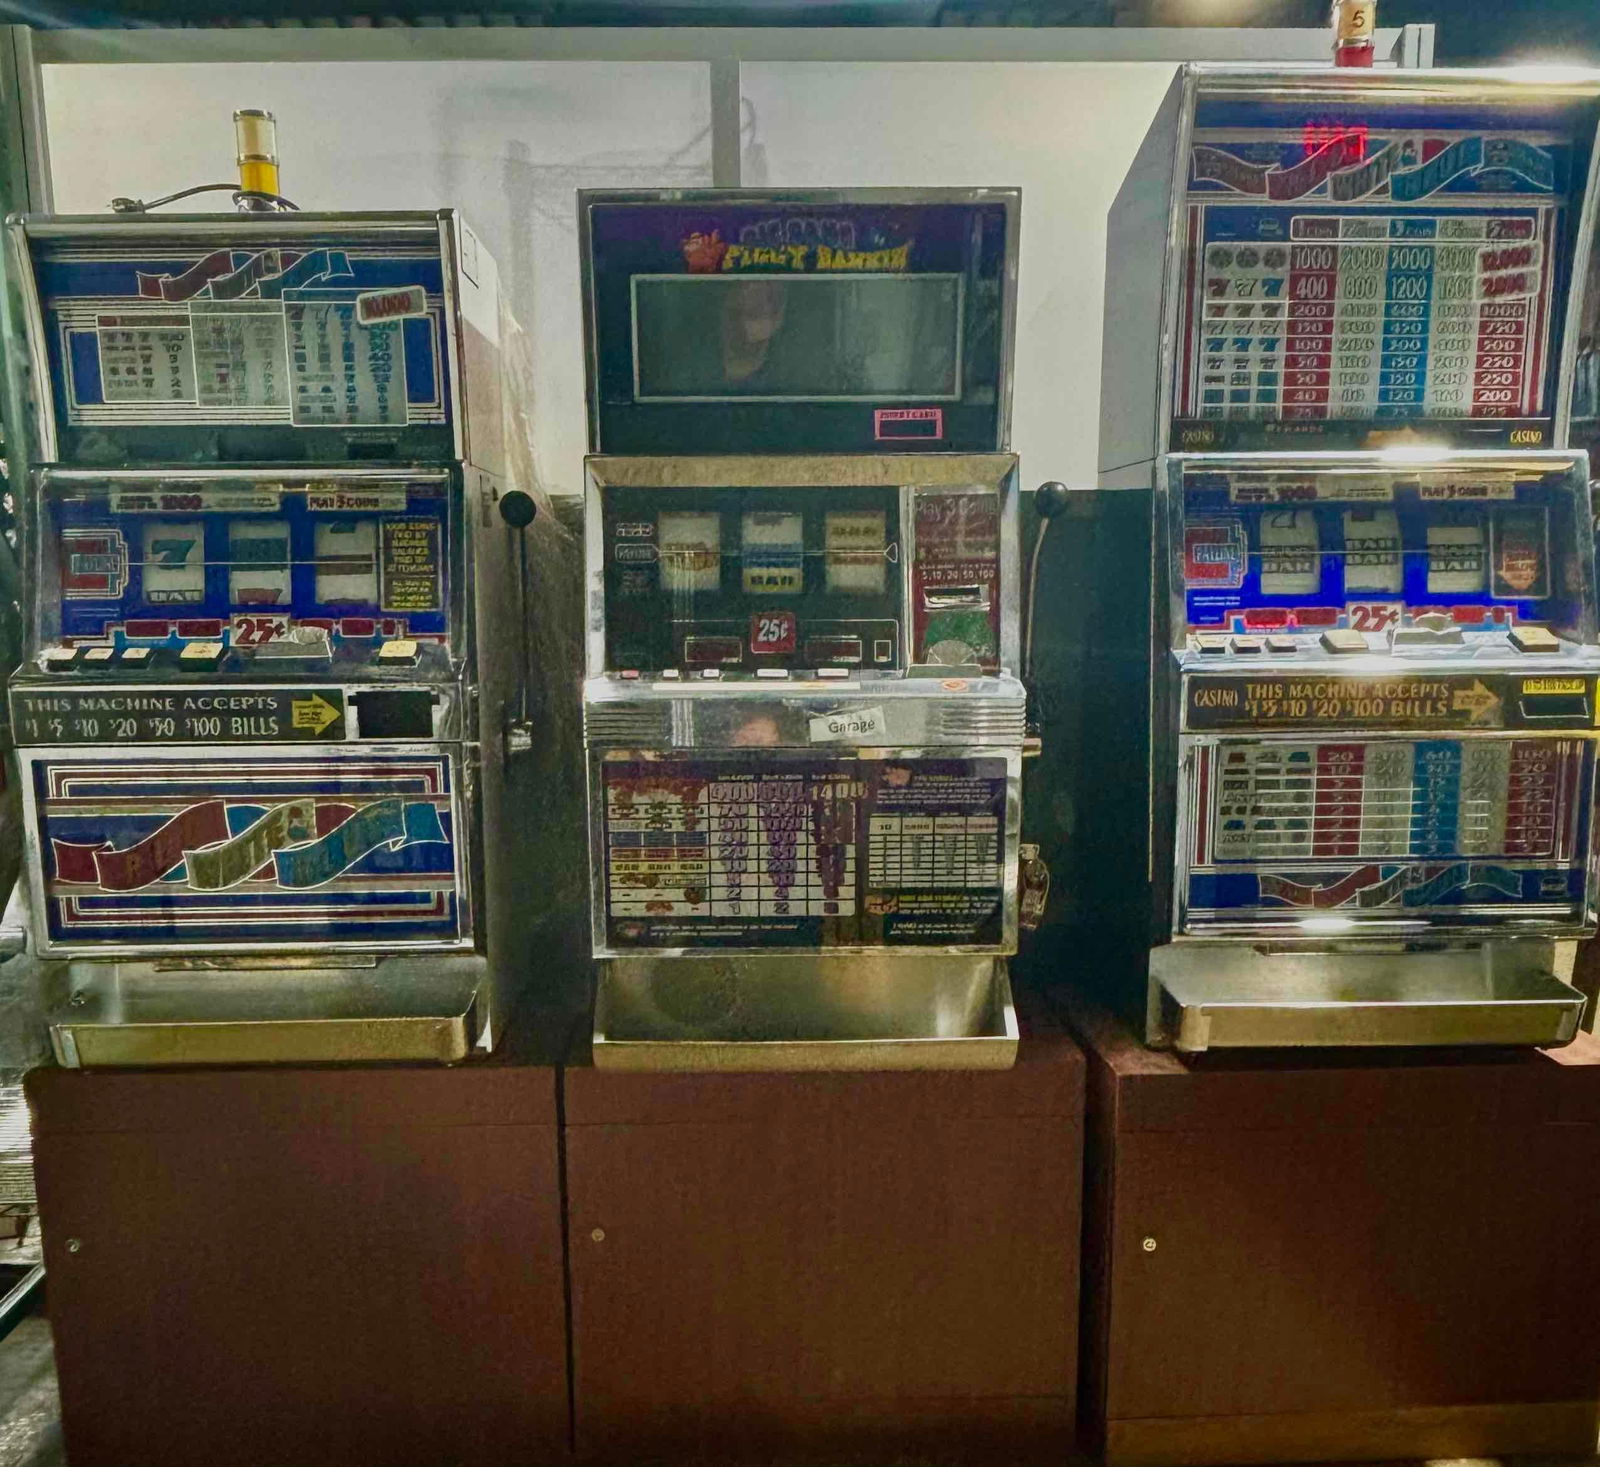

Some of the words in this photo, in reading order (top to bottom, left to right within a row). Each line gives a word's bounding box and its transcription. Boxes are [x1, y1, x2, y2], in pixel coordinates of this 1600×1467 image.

[1352, 9, 1365, 28] 5
[1295, 247, 1333, 270] 1000
[1296, 276, 1328, 299] 400
[1391, 274, 1427, 299] 1200
[1480, 372, 1512, 385] 250
[1478, 389, 1512, 402] 200
[1510, 430, 1542, 443] CASINO
[1351, 605, 1399, 632] 25¢
[235, 618, 286, 645] 25¢
[757, 618, 788, 642] 25¢
[1194, 688, 1239, 707] CASINO
[1245, 683, 1283, 699] THIS
[1288, 682, 1367, 699] MACHINE
[1374, 682, 1450, 699] ACCEPTS
[25, 699, 72, 712] THIS
[78, 698, 176, 712] MACHINE
[183, 696, 279, 711] ACCEPTS
[1390, 698, 1449, 717] BILLS
[231, 715, 279, 735] BILLS
[828, 719, 876, 734] Garage
